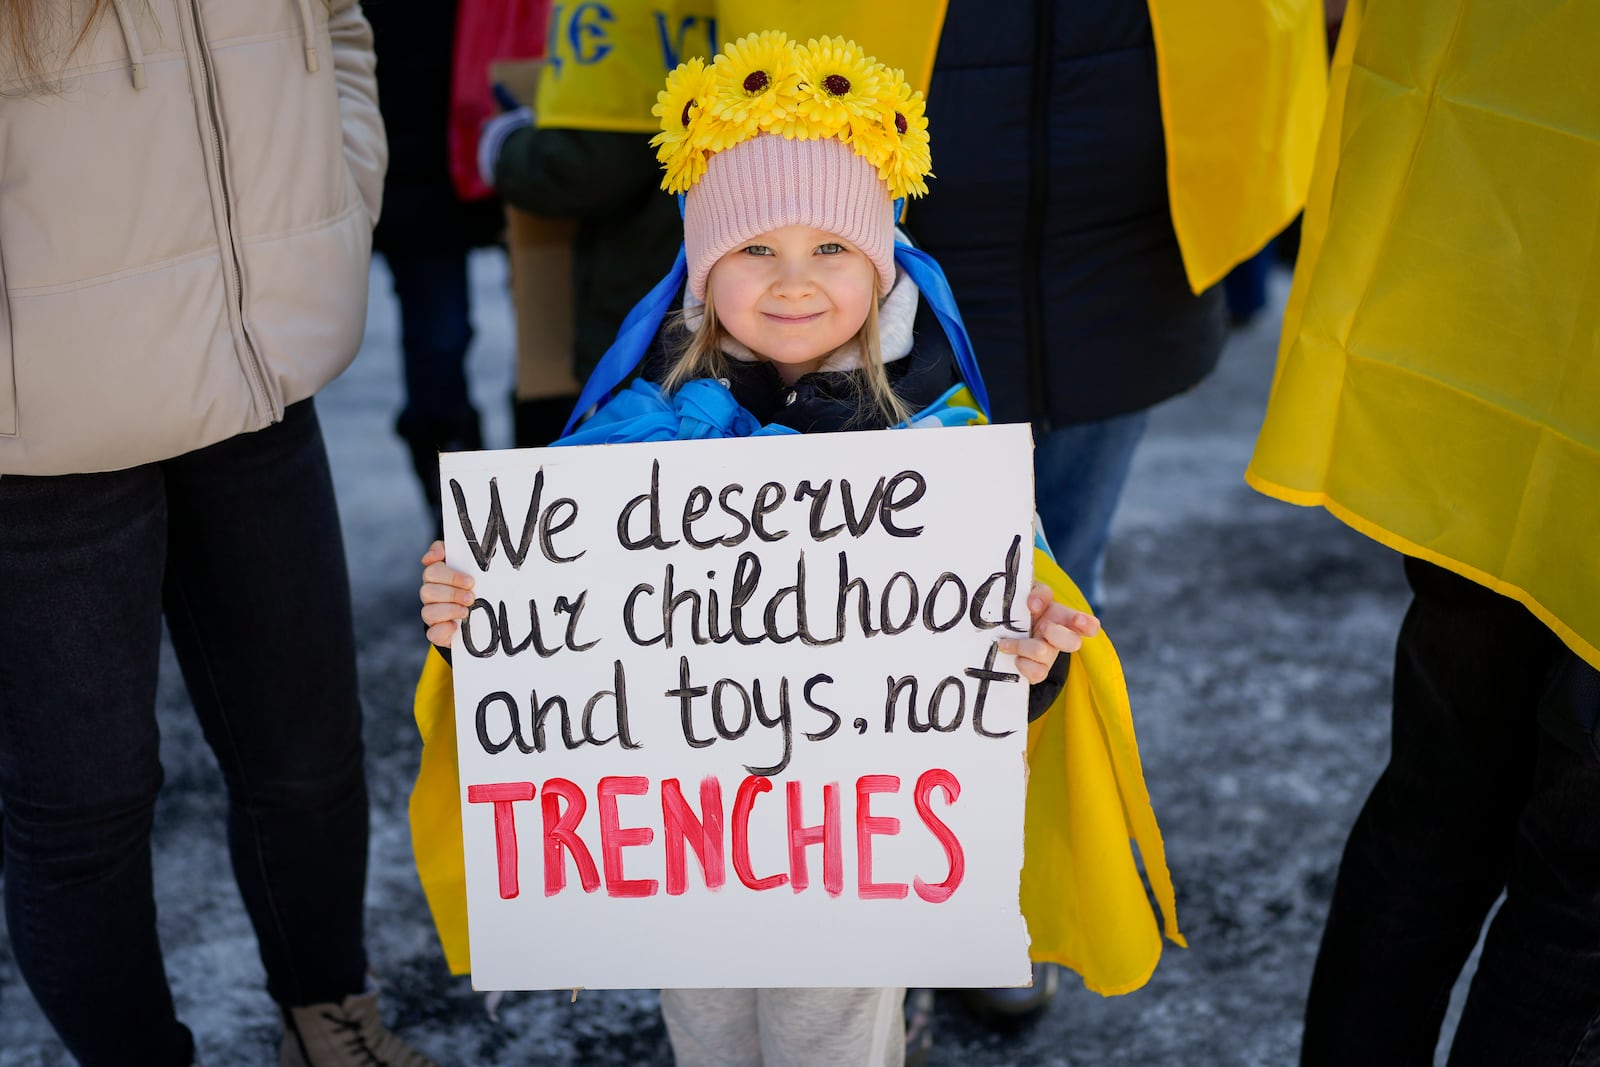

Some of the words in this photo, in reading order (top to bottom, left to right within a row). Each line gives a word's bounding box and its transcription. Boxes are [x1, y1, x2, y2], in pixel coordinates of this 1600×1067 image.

[449, 467, 586, 572] We
[616, 458, 927, 549] deserve
[462, 590, 602, 658] our
[623, 534, 1027, 648] childhood
[475, 659, 643, 754] and
[665, 655, 868, 776] toys,
[884, 641, 1020, 739] not
[468, 768, 965, 904] TRENCHES
